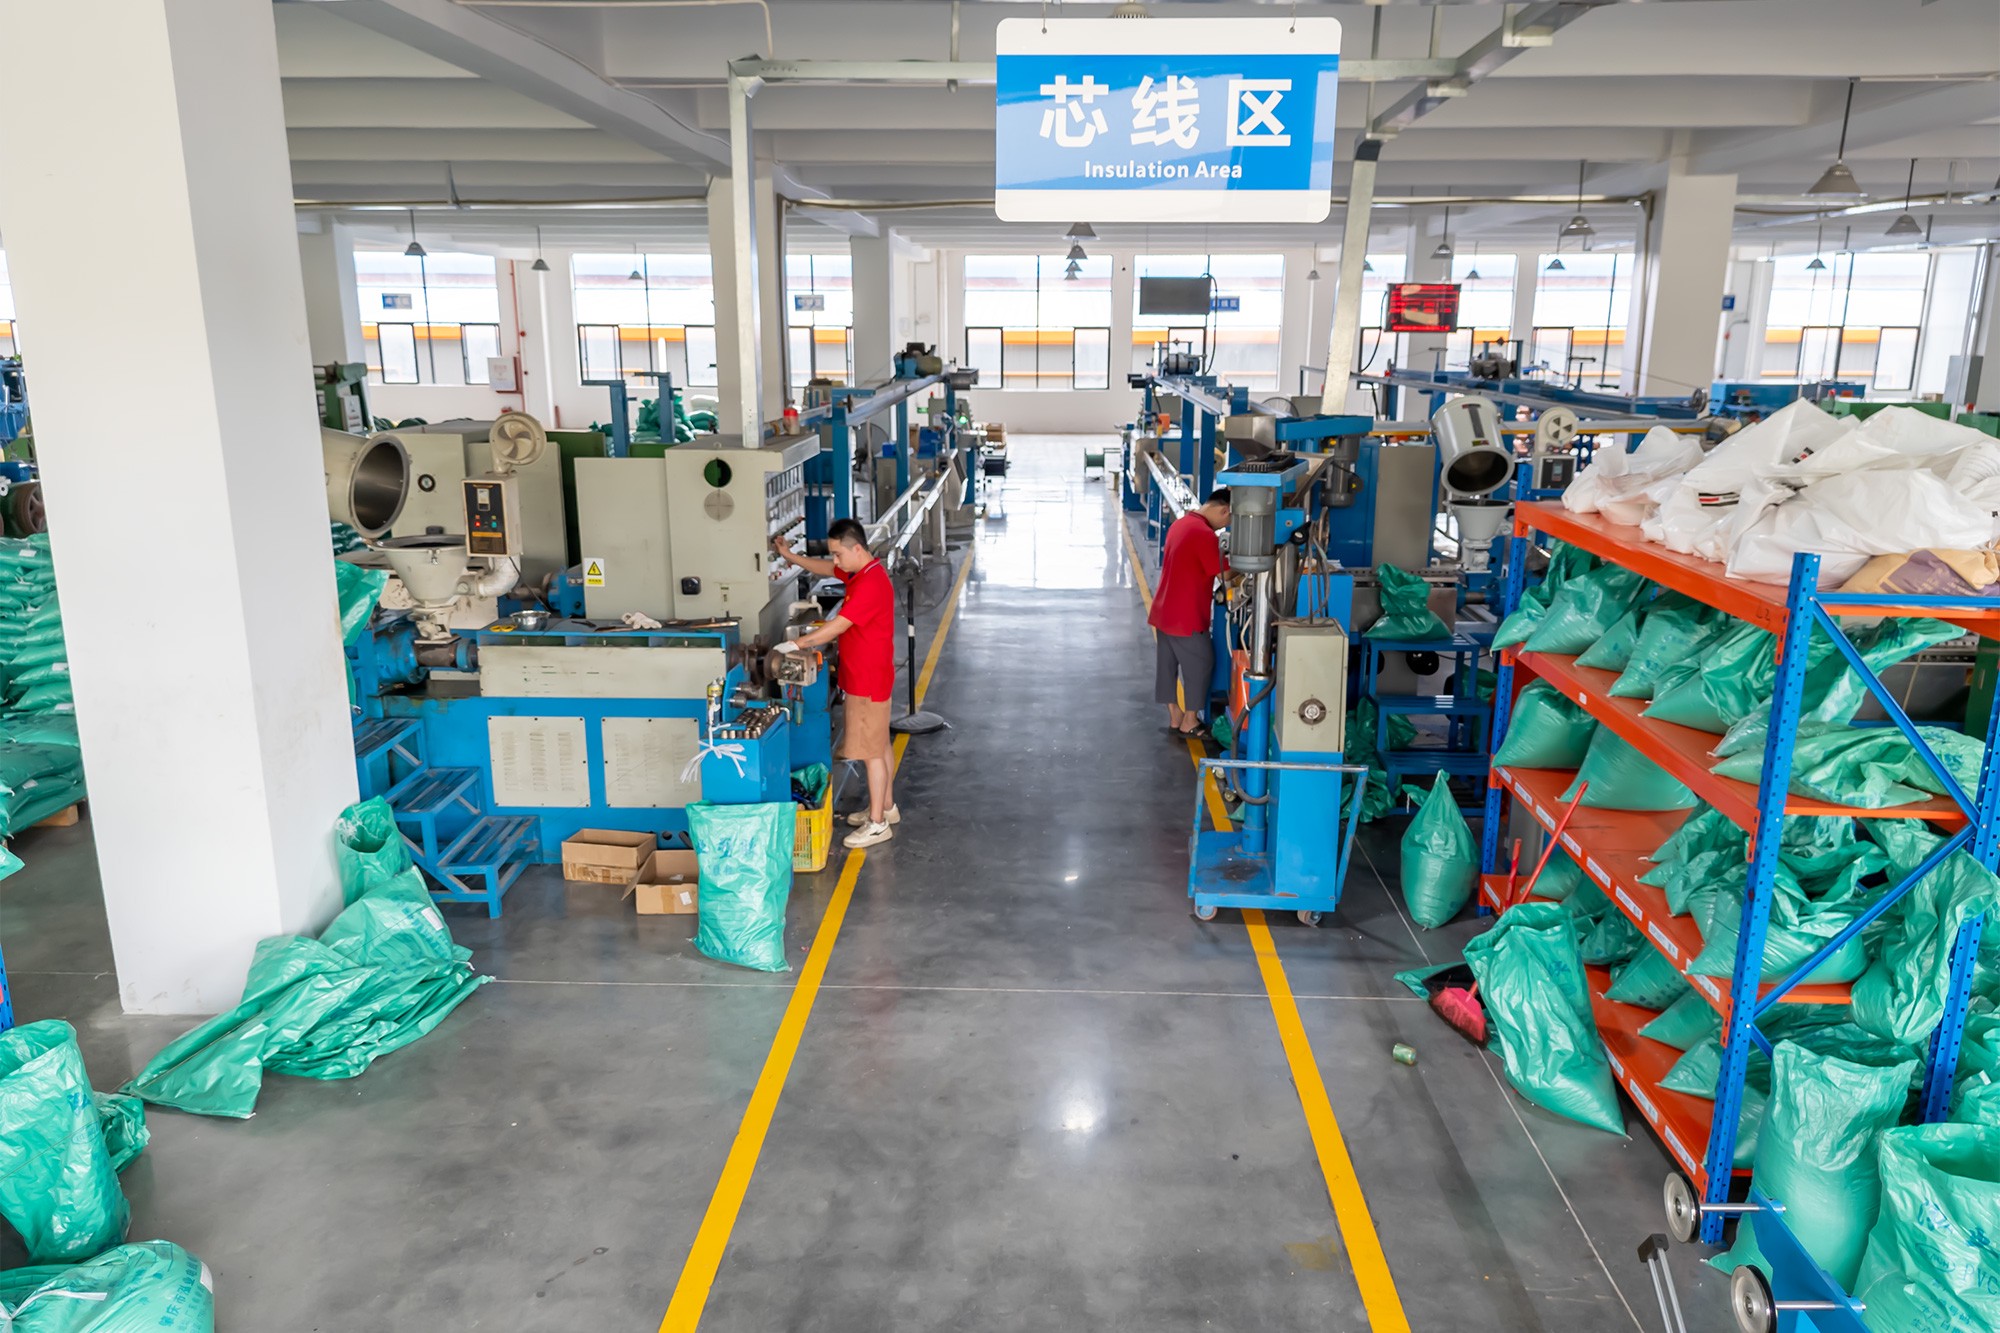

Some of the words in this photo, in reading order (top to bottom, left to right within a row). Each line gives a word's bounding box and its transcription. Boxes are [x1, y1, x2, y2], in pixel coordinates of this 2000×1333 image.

[1039, 74, 1292, 149] 芯线区
[1084, 160, 1190, 179] Insulation
[1194, 160, 1243, 179] Area
